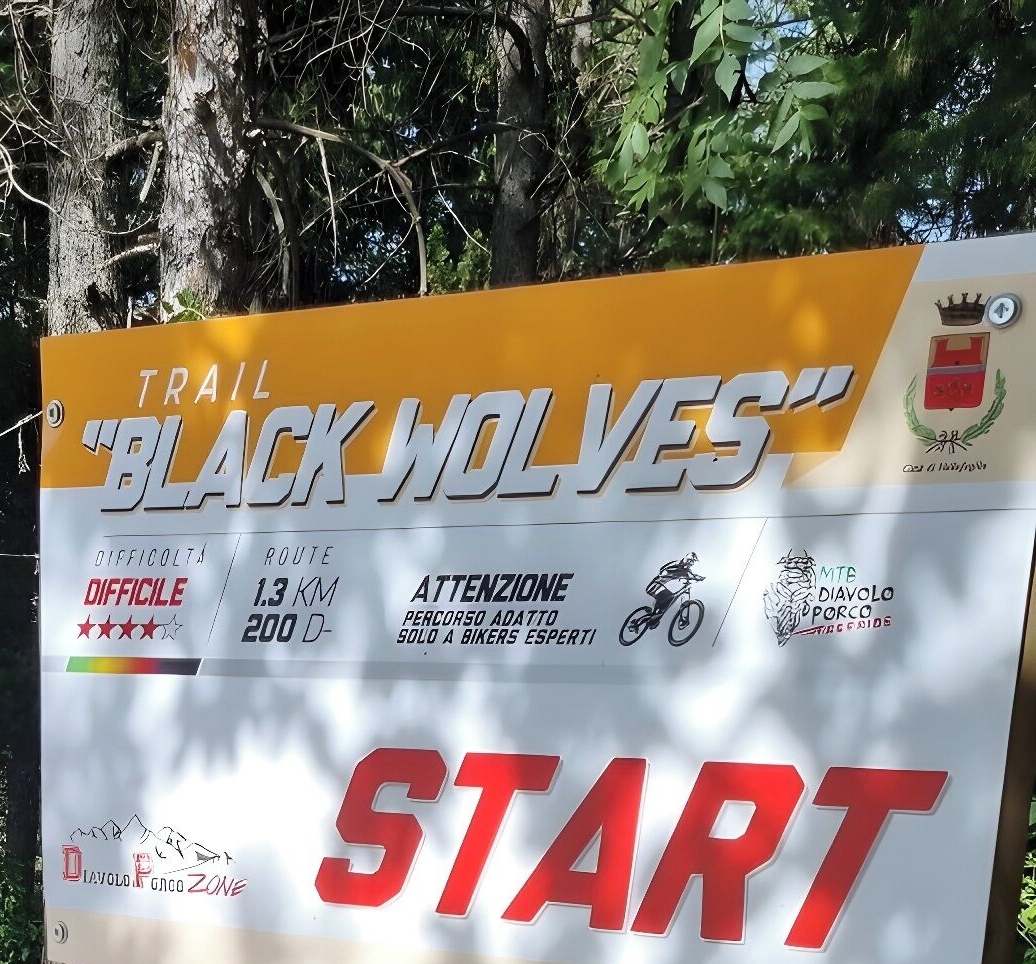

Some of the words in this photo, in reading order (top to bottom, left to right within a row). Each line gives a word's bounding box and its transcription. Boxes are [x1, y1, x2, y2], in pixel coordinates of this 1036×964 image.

[137, 360, 271, 408] TRAIL
[263, 546, 335, 566] ROUTE
[819, 565, 857, 583] MTB
[83, 577, 189, 607] DIFFICILE
[253, 577, 289, 607] 1.3
[292, 576, 341, 607] KM
[410, 572, 575, 603] ATTENZIONE
[817, 584, 895, 602] DIAVOLO
[401, 610, 487, 627] PERCORSO
[489, 609, 560, 627] ADATTO
[811, 604, 873, 625] PORCO
[240, 613, 299, 643] 200
[396, 628, 439, 645] SOLO
[442, 629, 455, 645] A
[460, 628, 520, 645] BIKERS
[524, 628, 598, 646] ESPERTI
[314, 747, 950, 952] START
[187, 873, 249, 897] ZONE
